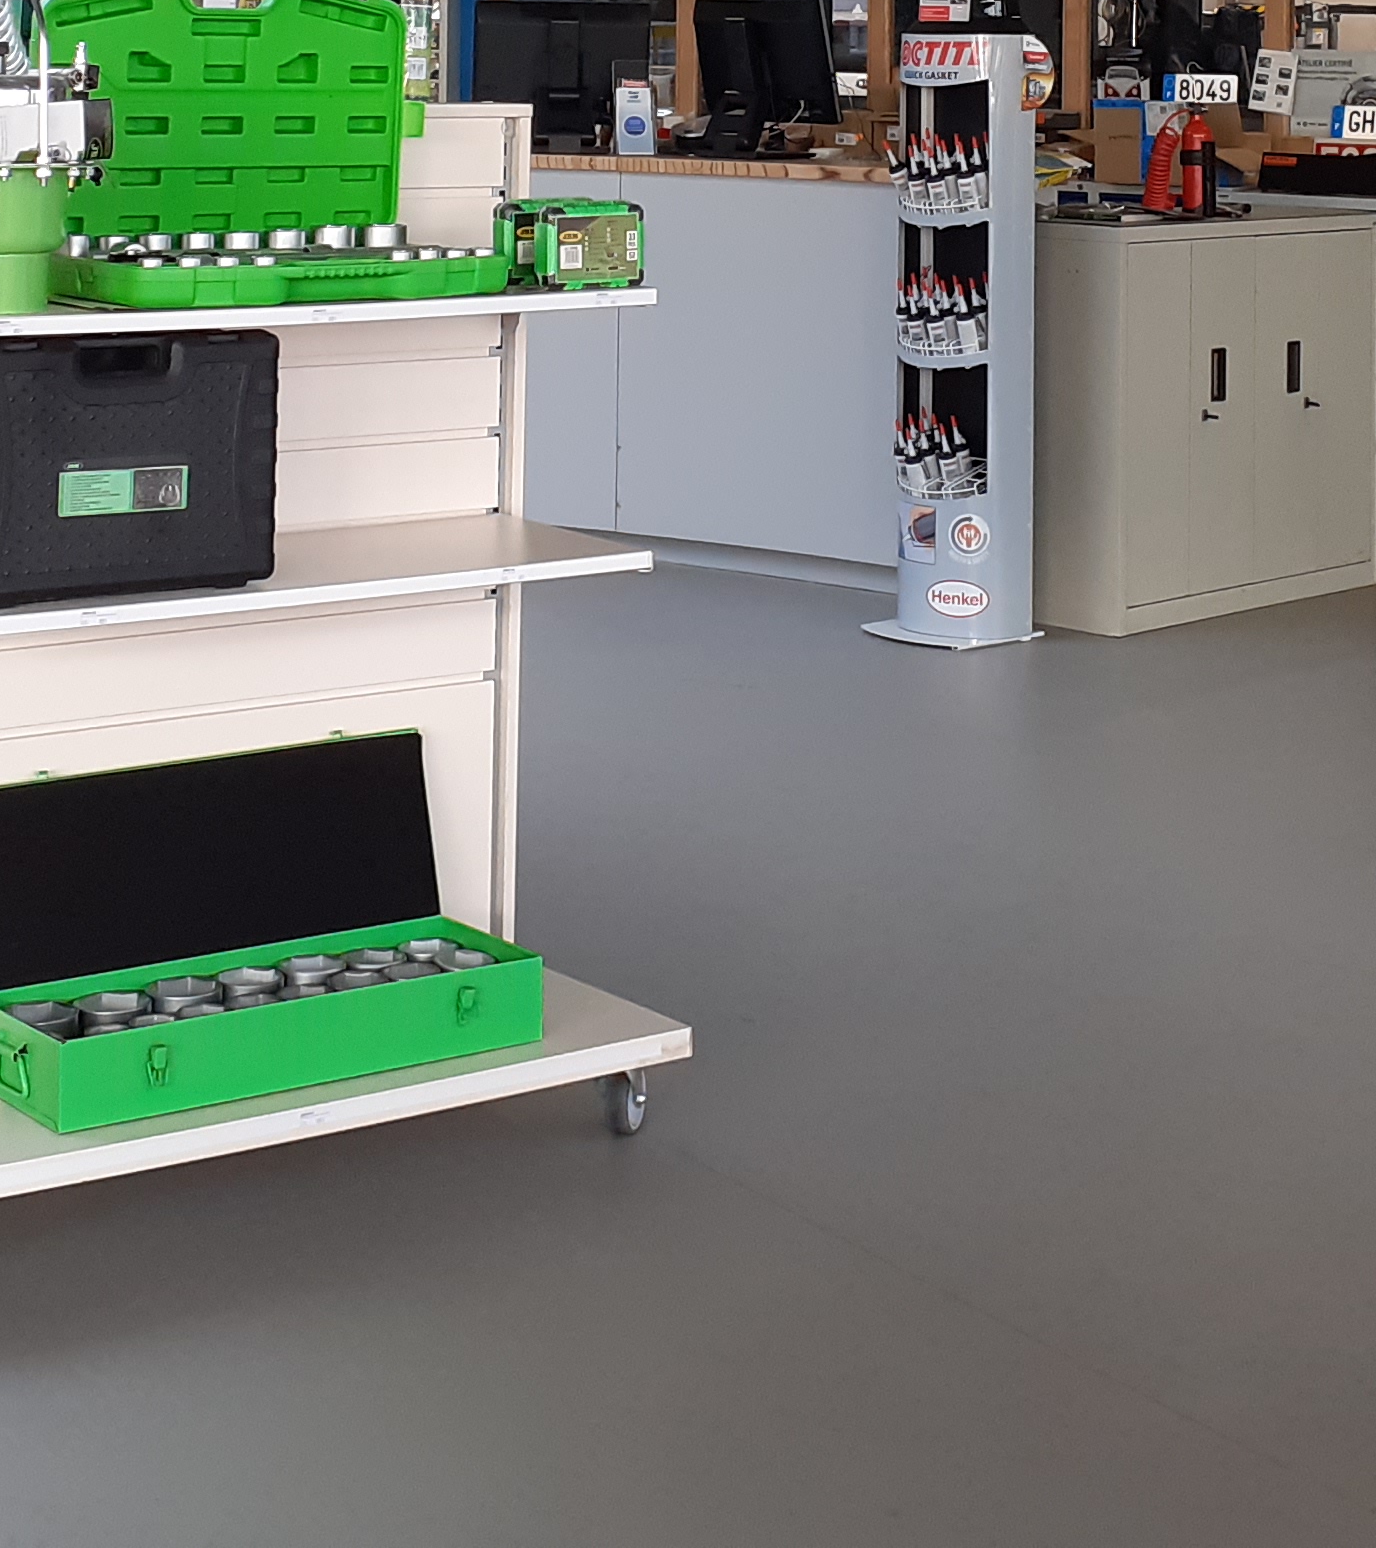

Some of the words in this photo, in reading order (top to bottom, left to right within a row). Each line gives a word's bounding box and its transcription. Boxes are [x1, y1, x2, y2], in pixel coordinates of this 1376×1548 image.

[924, 71, 960, 81] GASKET
[1178, 79, 1232, 102] 8049
[931, 589, 985, 607] Henkel
